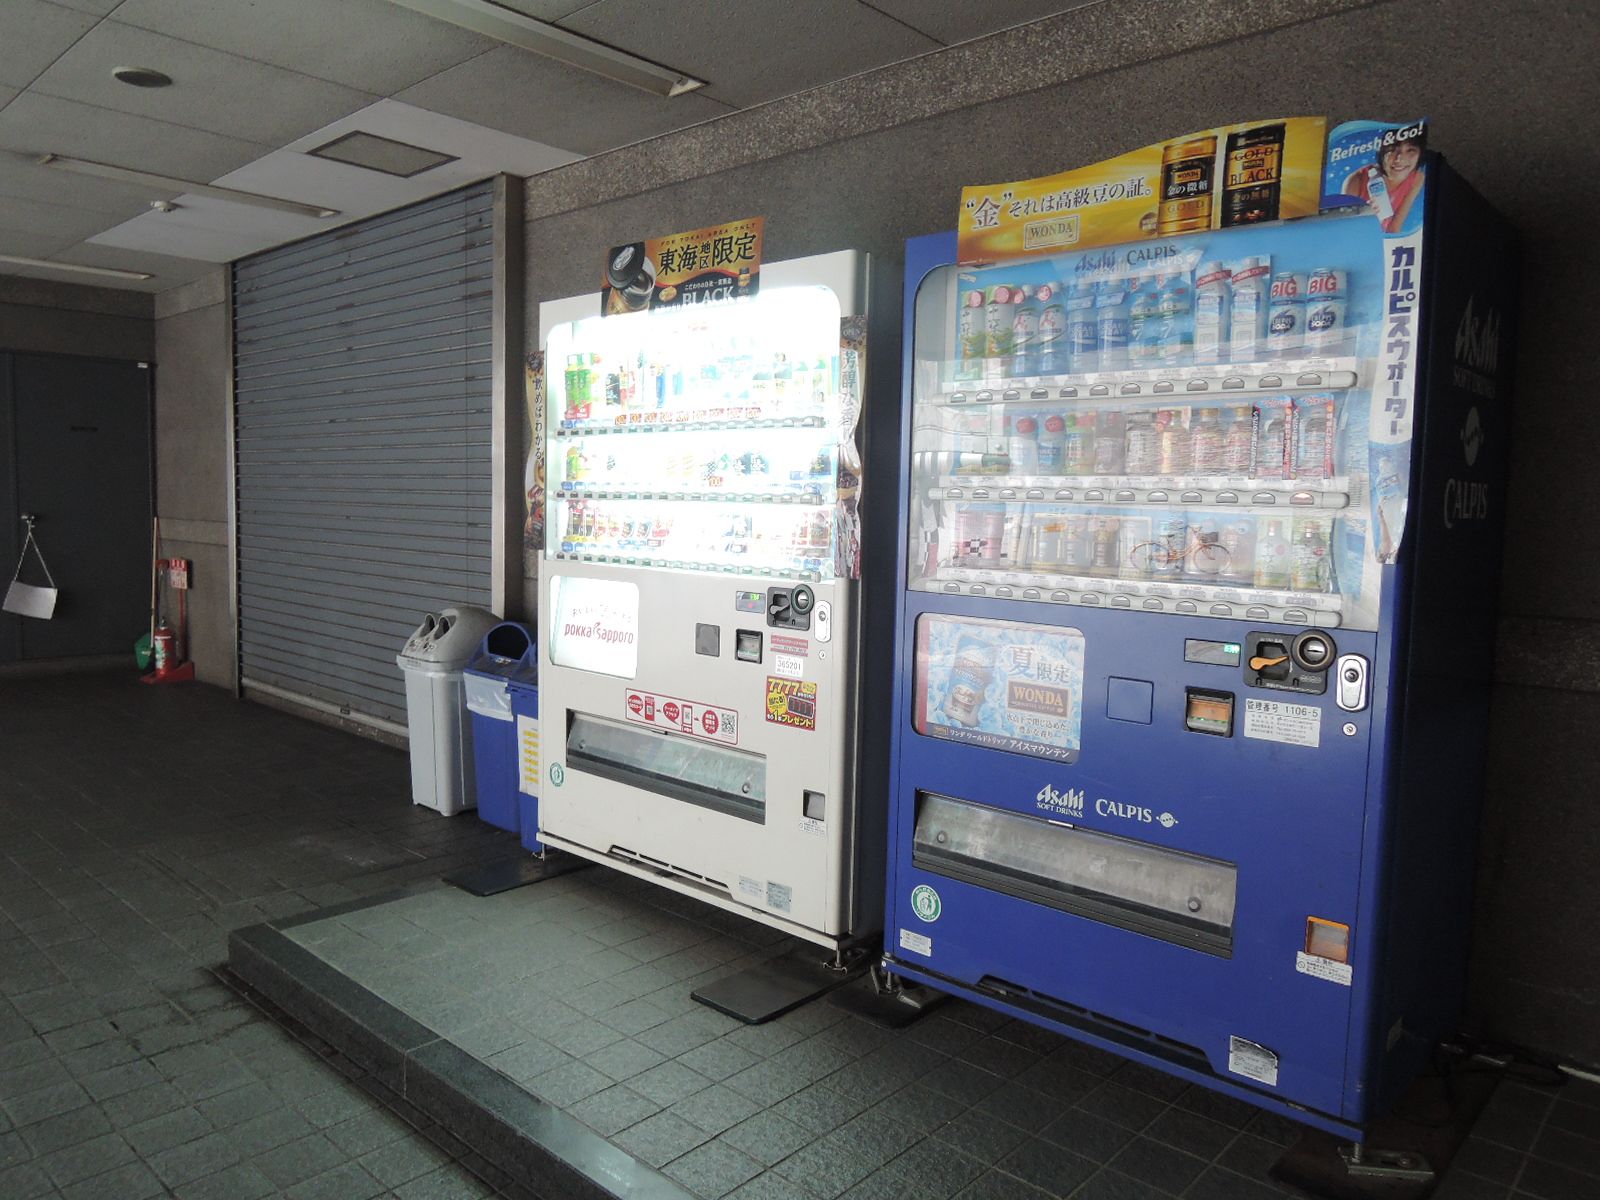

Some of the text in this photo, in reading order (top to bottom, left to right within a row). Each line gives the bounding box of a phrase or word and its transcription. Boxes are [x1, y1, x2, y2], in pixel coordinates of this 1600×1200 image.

[1234, 147, 1275, 162] GOLD
[1330, 136, 1382, 162] Refresh
[1230, 167, 1274, 186] BLACK
[708, 229, 730, 238] AREA
[734, 222, 757, 233] ONLY
[1030, 221, 1073, 239] WONDA
[1126, 244, 1177, 266] CALPIS
[682, 285, 735, 305] BLACK
[1271, 280, 1297, 298] BIG
[1308, 276, 1337, 295] BIG
[1384, 245, 1416, 436] カルピスウォーター
[1444, 478, 1488, 529] CALPIS
[768, 678, 800, 696] 7777
[1013, 686, 1065, 707] WONDA
[1247, 699, 1319, 718] 管理番号 1106-5
[1009, 739, 1070, 759] アイスマウンテン
[1036, 783, 1085, 811] Asahi
[1036, 802, 1083, 819] SOFT DRINKS
[1095, 798, 1153, 823] CALPIS
